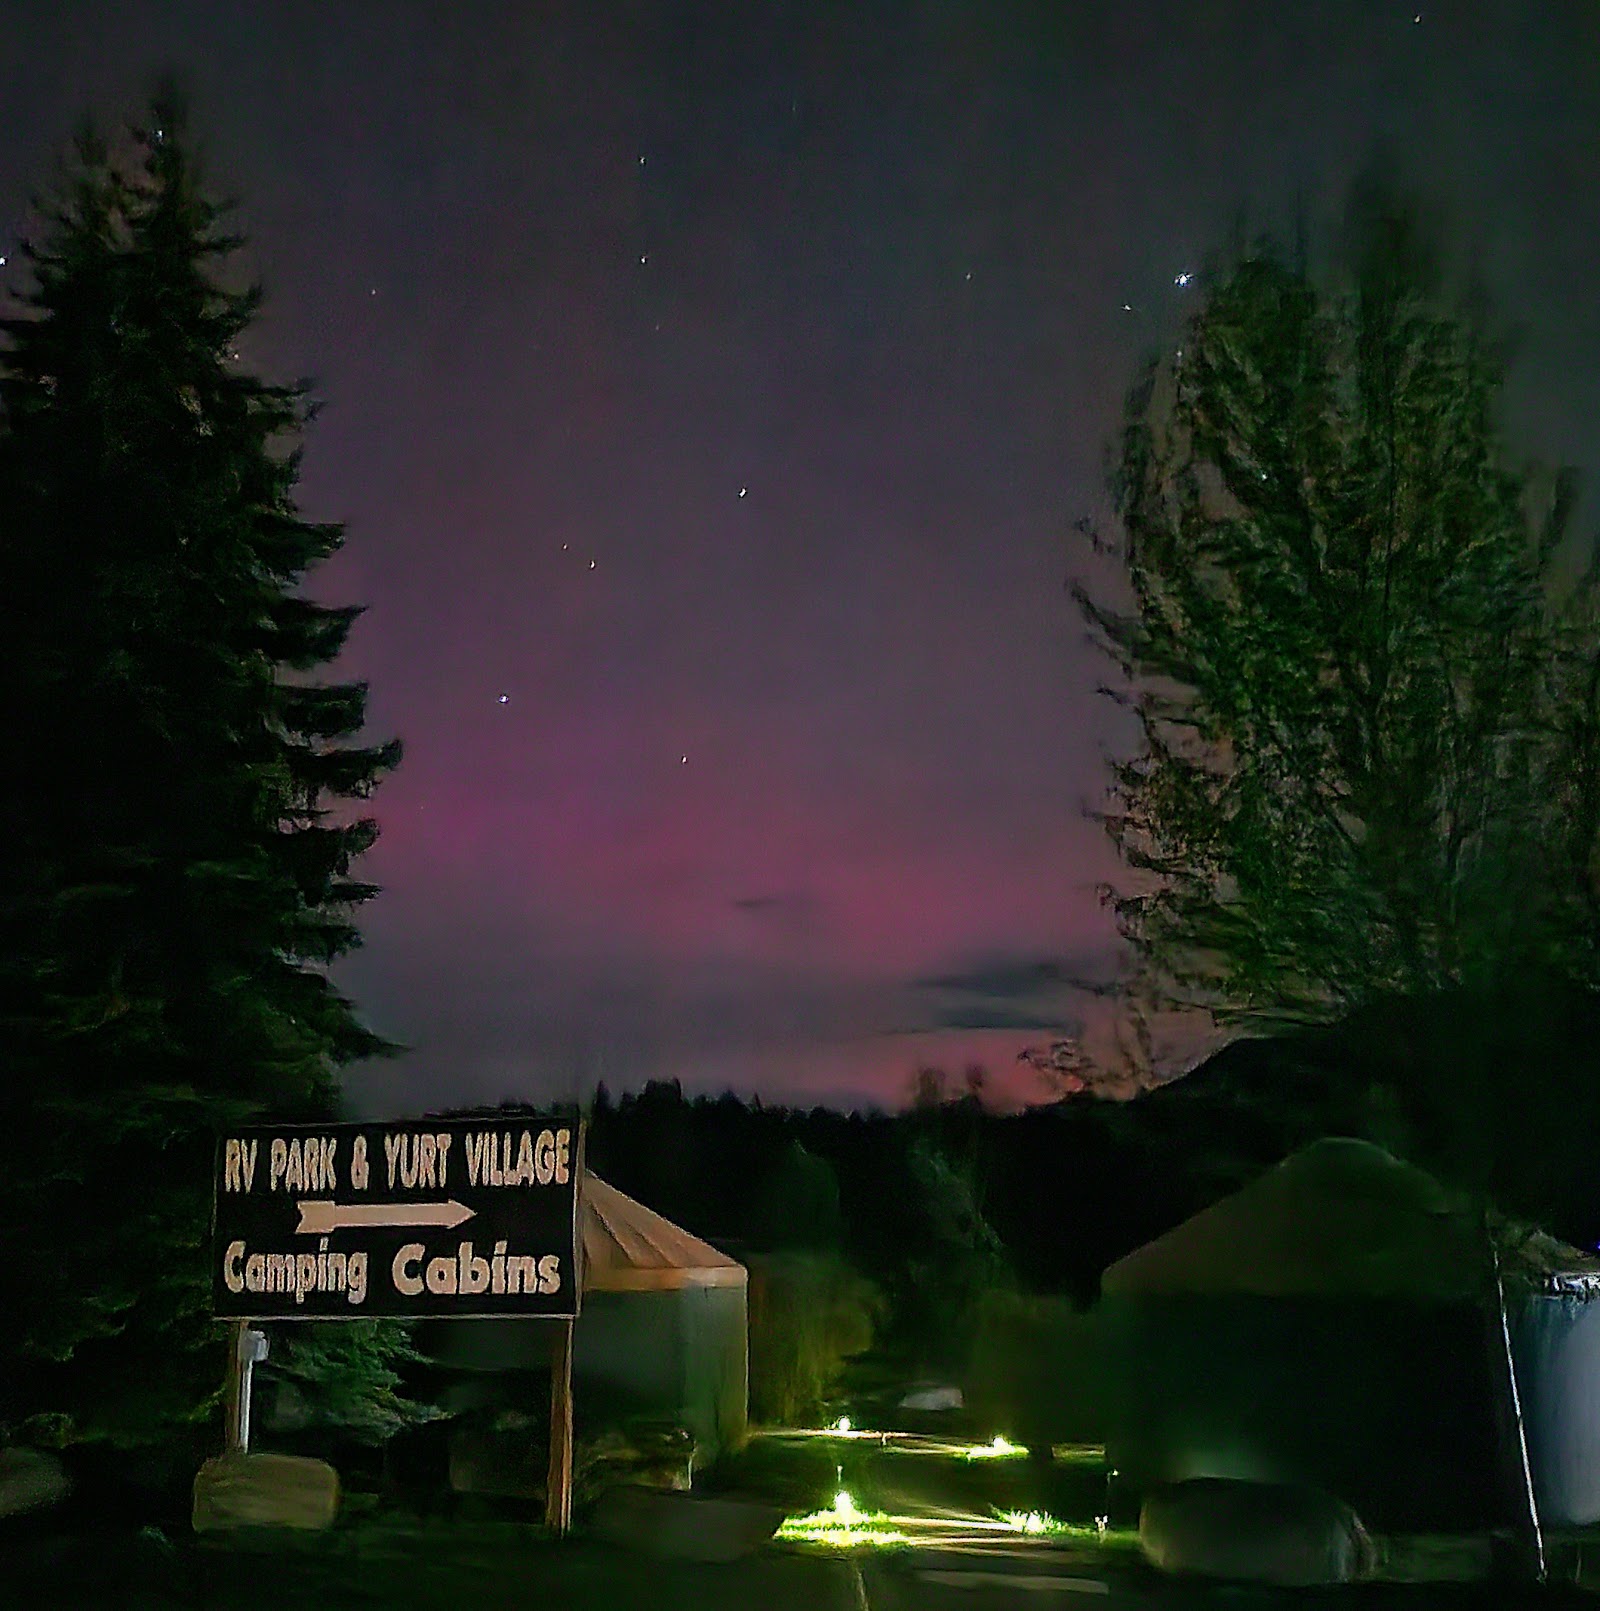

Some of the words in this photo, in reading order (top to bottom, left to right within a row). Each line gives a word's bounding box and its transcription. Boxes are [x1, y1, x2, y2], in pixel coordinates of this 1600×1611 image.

[225, 1139, 257, 1192] RV
[270, 1137, 336, 1192] PARK
[351, 1136, 369, 1189] &
[384, 1134, 452, 1189] YURT
[465, 1129, 570, 1187] VILLAGE
[224, 1237, 367, 1304] Camping
[392, 1241, 560, 1295] Cabins
